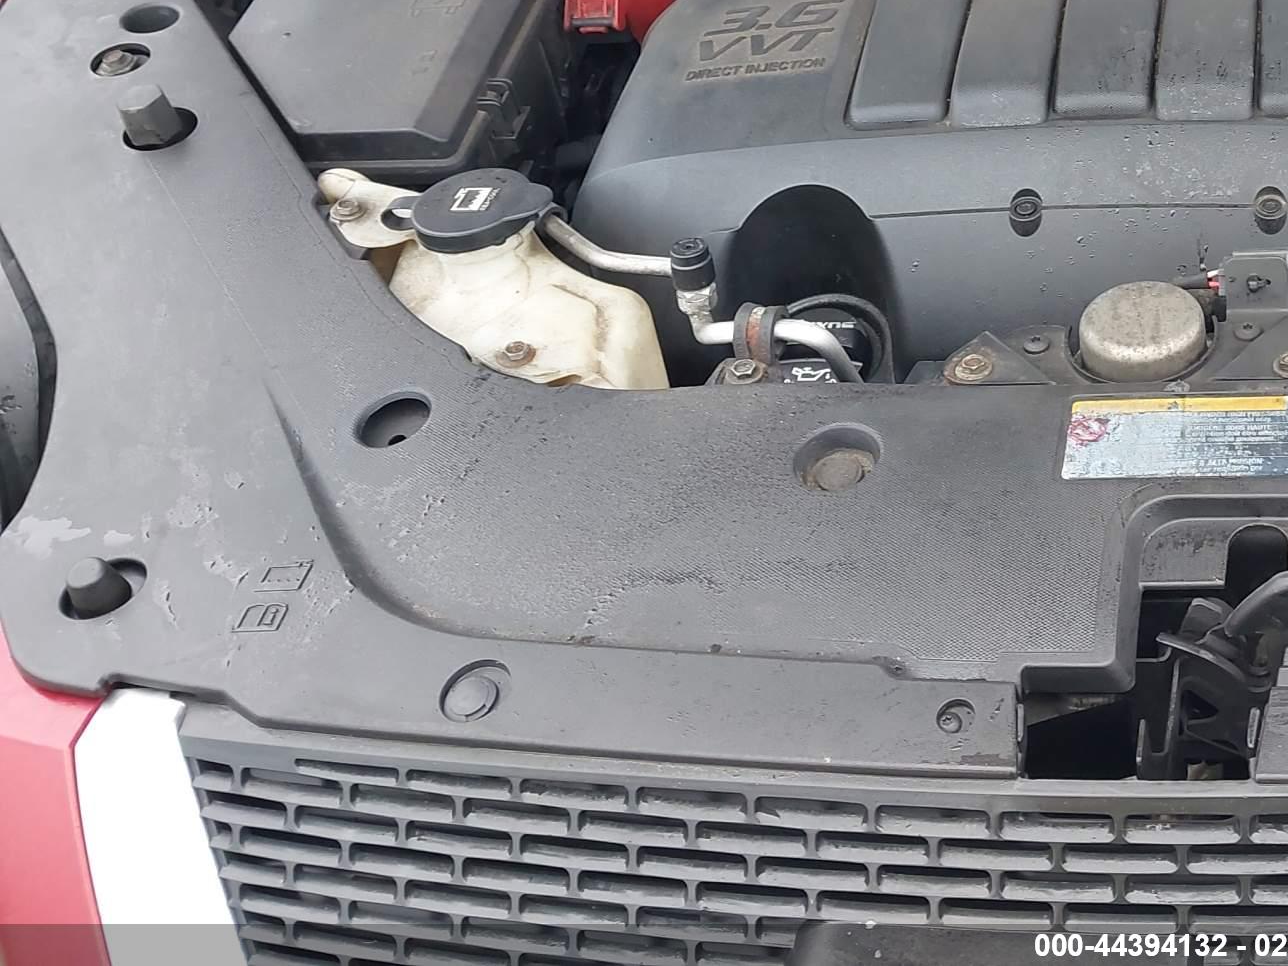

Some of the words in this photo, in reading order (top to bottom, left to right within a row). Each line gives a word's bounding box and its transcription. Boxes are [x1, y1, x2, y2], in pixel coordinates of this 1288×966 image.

[699, 27, 835, 62] VVT
[684, 65, 743, 82] DIRECT
[744, 57, 827, 75] INJECTION
